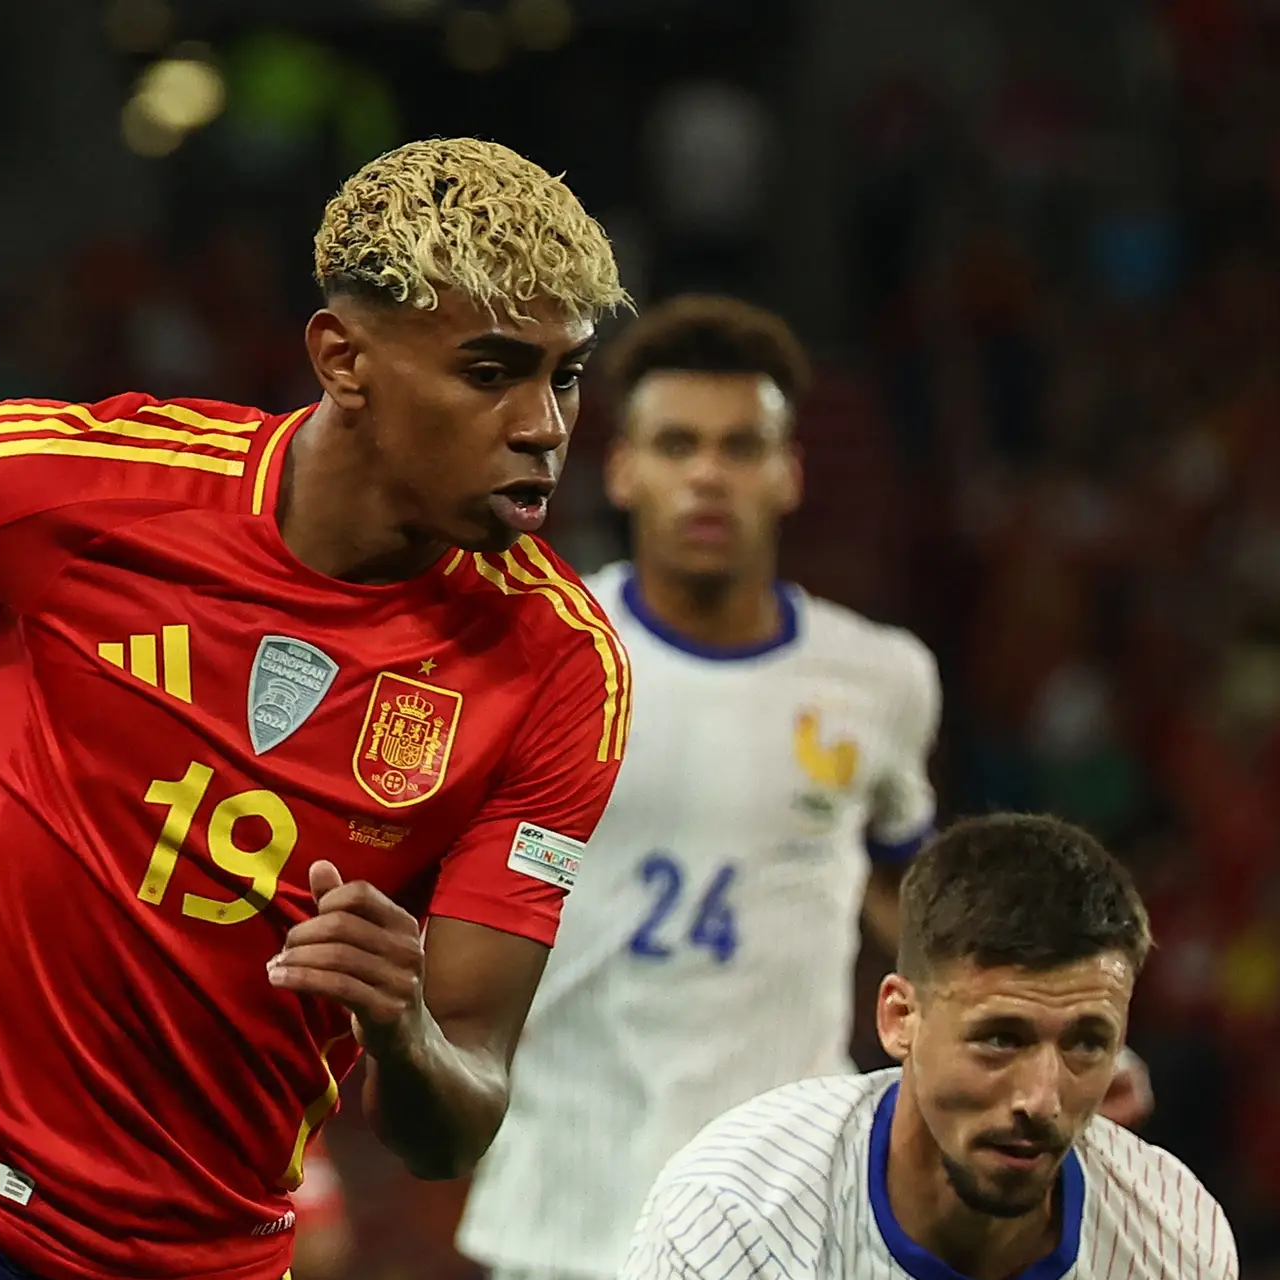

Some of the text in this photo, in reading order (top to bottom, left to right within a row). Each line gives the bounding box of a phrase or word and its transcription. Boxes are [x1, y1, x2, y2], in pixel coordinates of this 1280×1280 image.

[263, 649, 328, 681] EUROPEAN
[255, 710, 287, 732] 2024
[137, 761, 298, 924] 19
[520, 826, 544, 840] UEFA
[627, 850, 738, 965] 24
